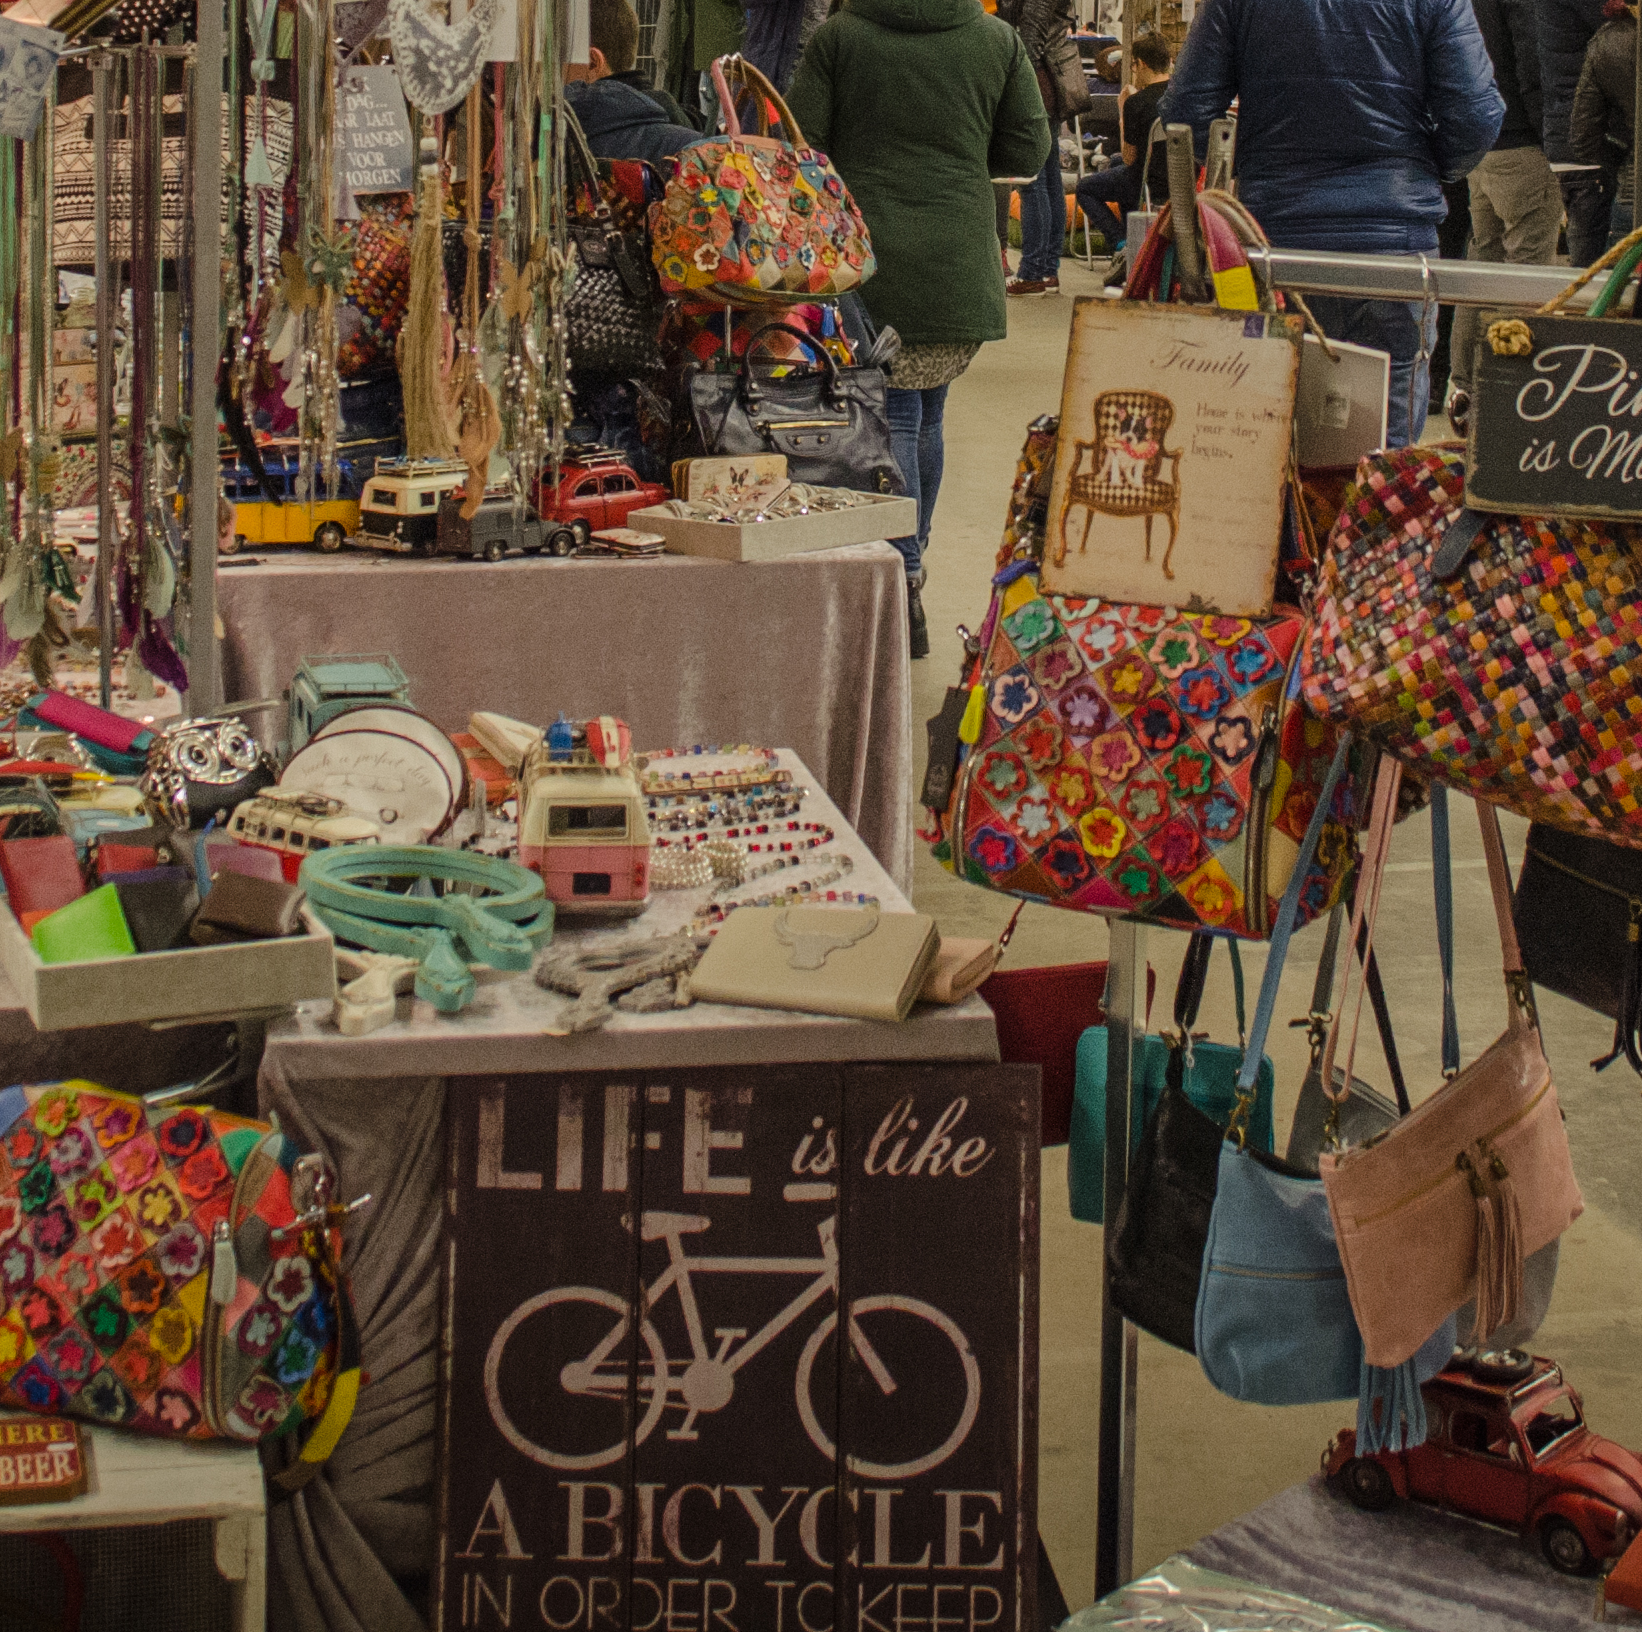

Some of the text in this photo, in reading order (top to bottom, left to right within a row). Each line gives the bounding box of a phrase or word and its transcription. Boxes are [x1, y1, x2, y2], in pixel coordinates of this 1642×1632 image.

[1154, 338, 1252, 389] Family
[1519, 438, 1561, 473] is
[476, 1082, 997, 1194] LIFE is like
[455, 1478, 1006, 1571] A BICYCLE
[461, 1574, 1004, 1632] IN ORDER TO KEEP
